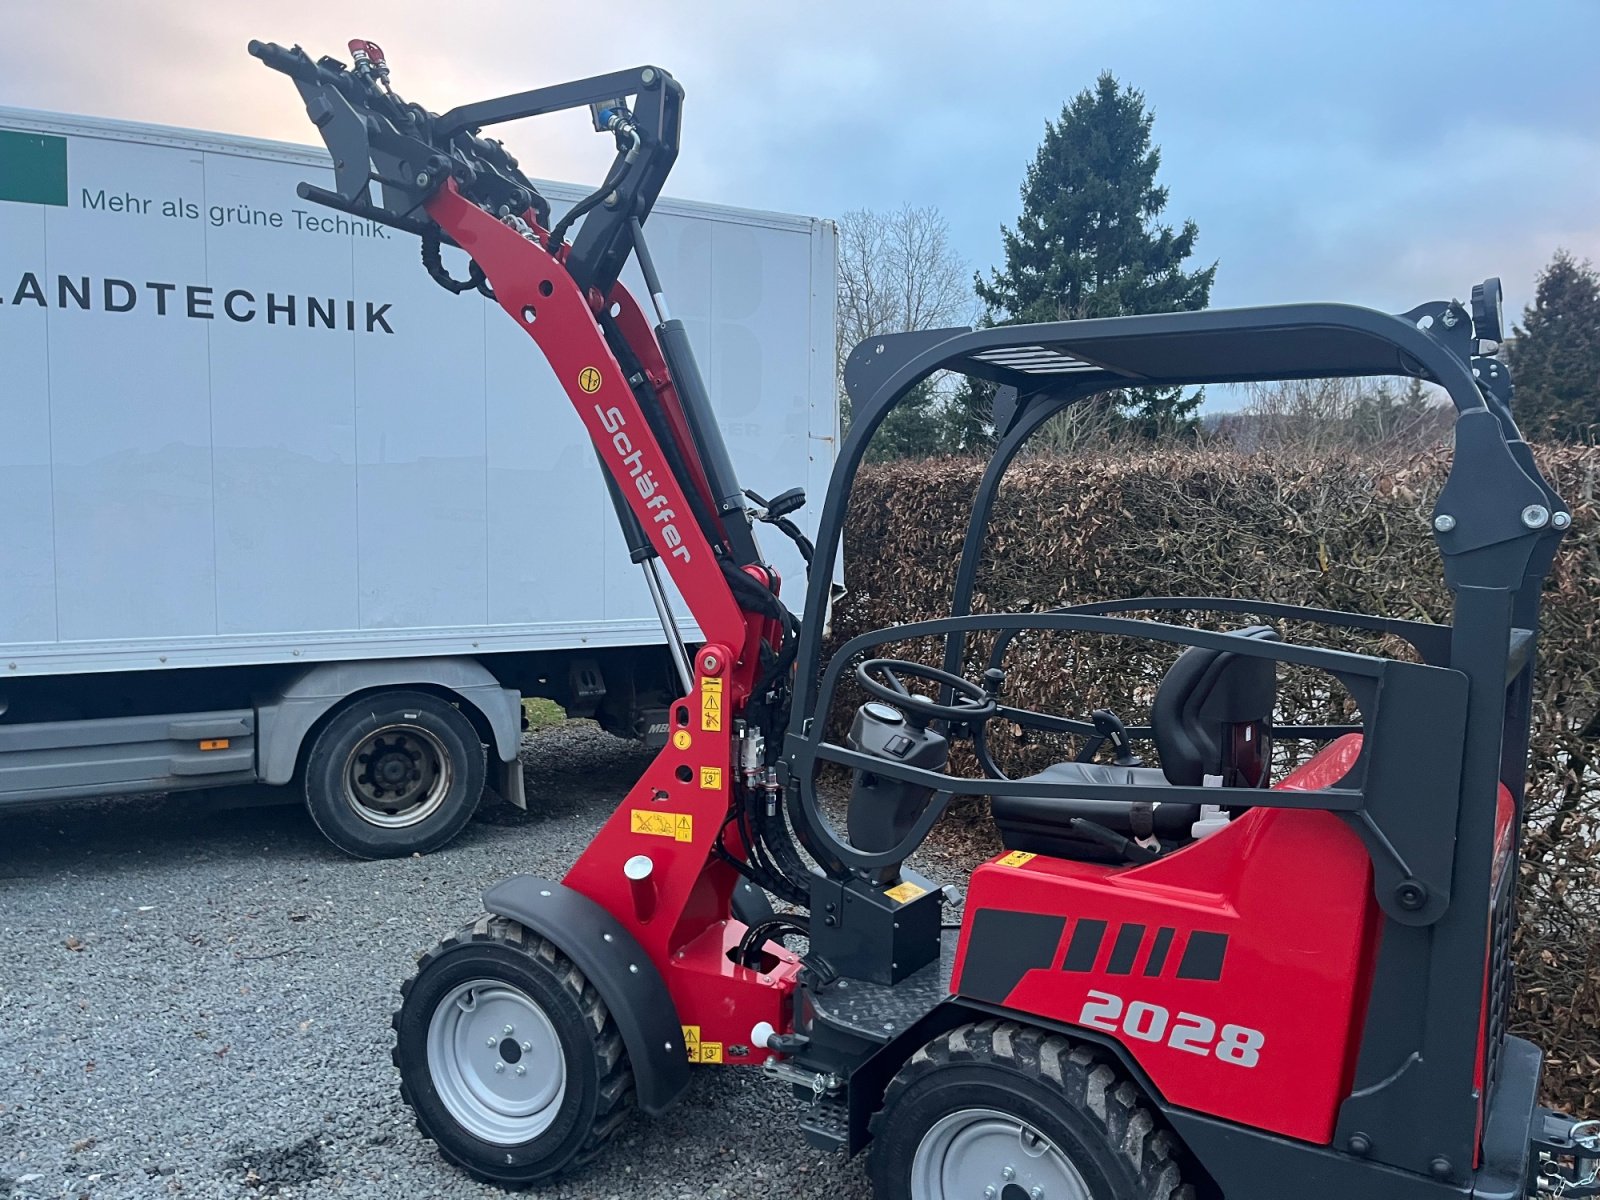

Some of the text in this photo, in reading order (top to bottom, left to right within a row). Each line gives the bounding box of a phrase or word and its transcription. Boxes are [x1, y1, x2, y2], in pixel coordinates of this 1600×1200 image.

[82, 188, 392, 240] Mehr als grüne Technik.
[0, 272, 394, 334] ANDTECHNIK
[594, 404, 692, 564] Schäffer
[648, 723, 671, 734] MB
[1078, 989, 1266, 1069] 2028
